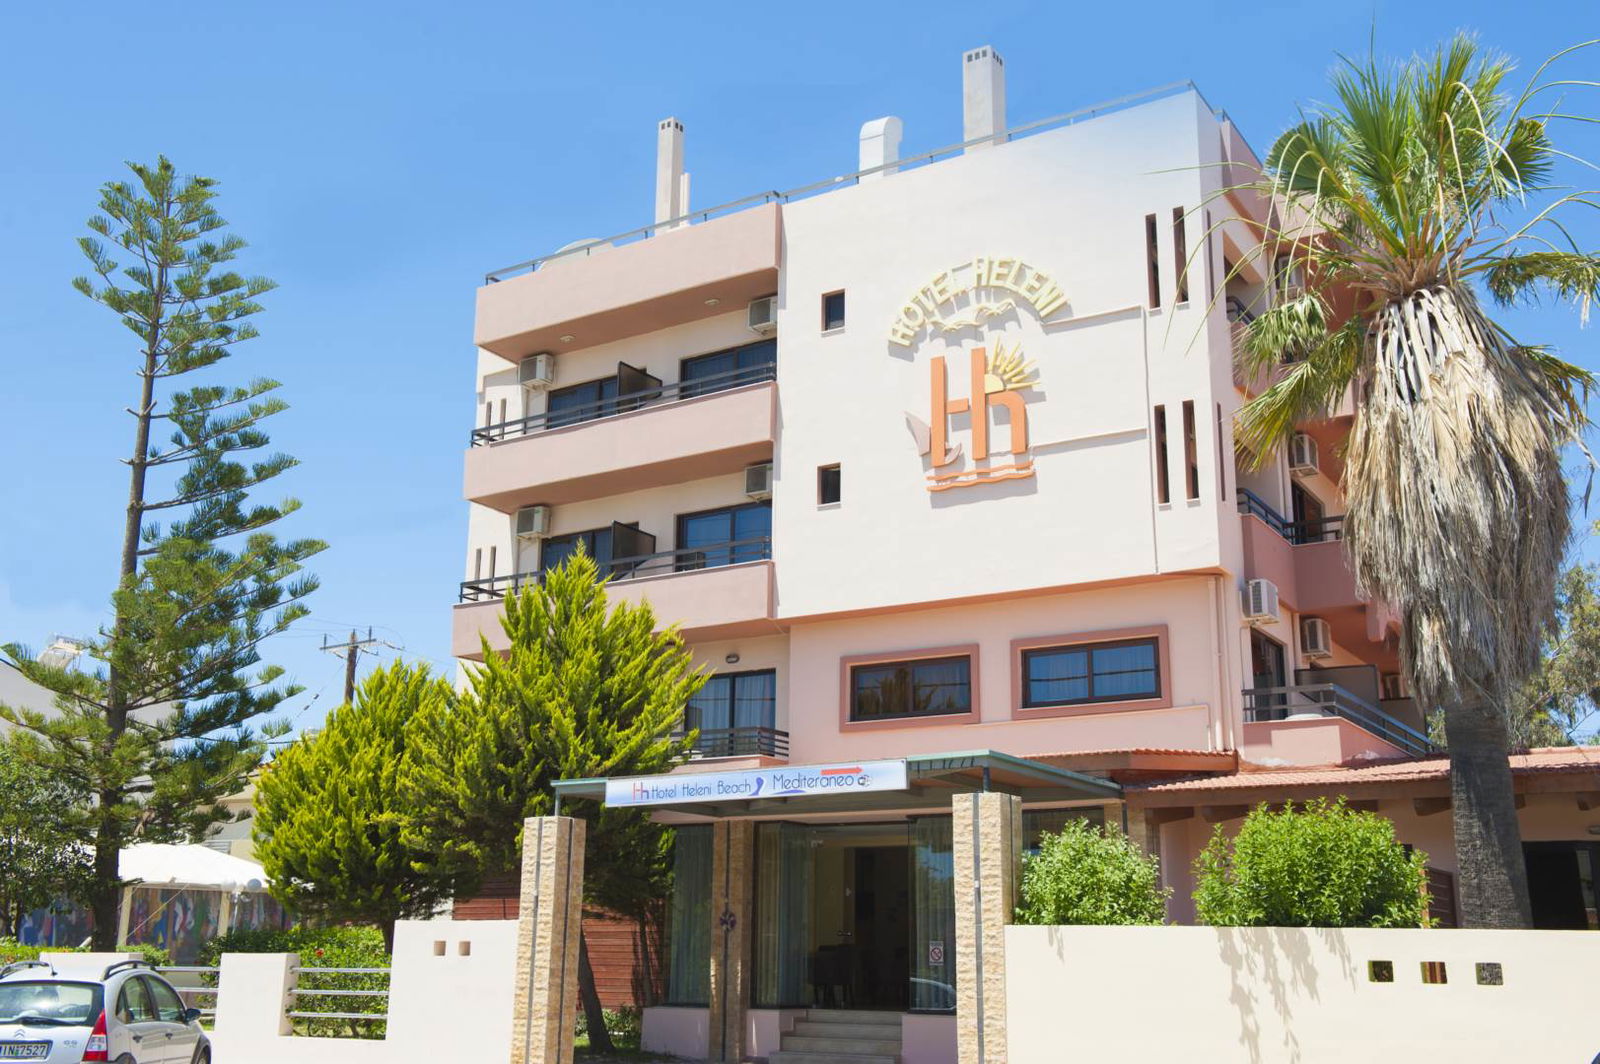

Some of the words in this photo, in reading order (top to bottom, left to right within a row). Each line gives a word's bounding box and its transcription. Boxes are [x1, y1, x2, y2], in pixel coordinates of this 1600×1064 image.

[888, 269, 973, 345] HOTEL
[974, 256, 1071, 317] HELENI
[651, 783, 677, 799] Hotel
[682, 782, 712, 797] Heleni
[717, 779, 752, 795] Beach
[773, 772, 854, 790] Mediteraneo
